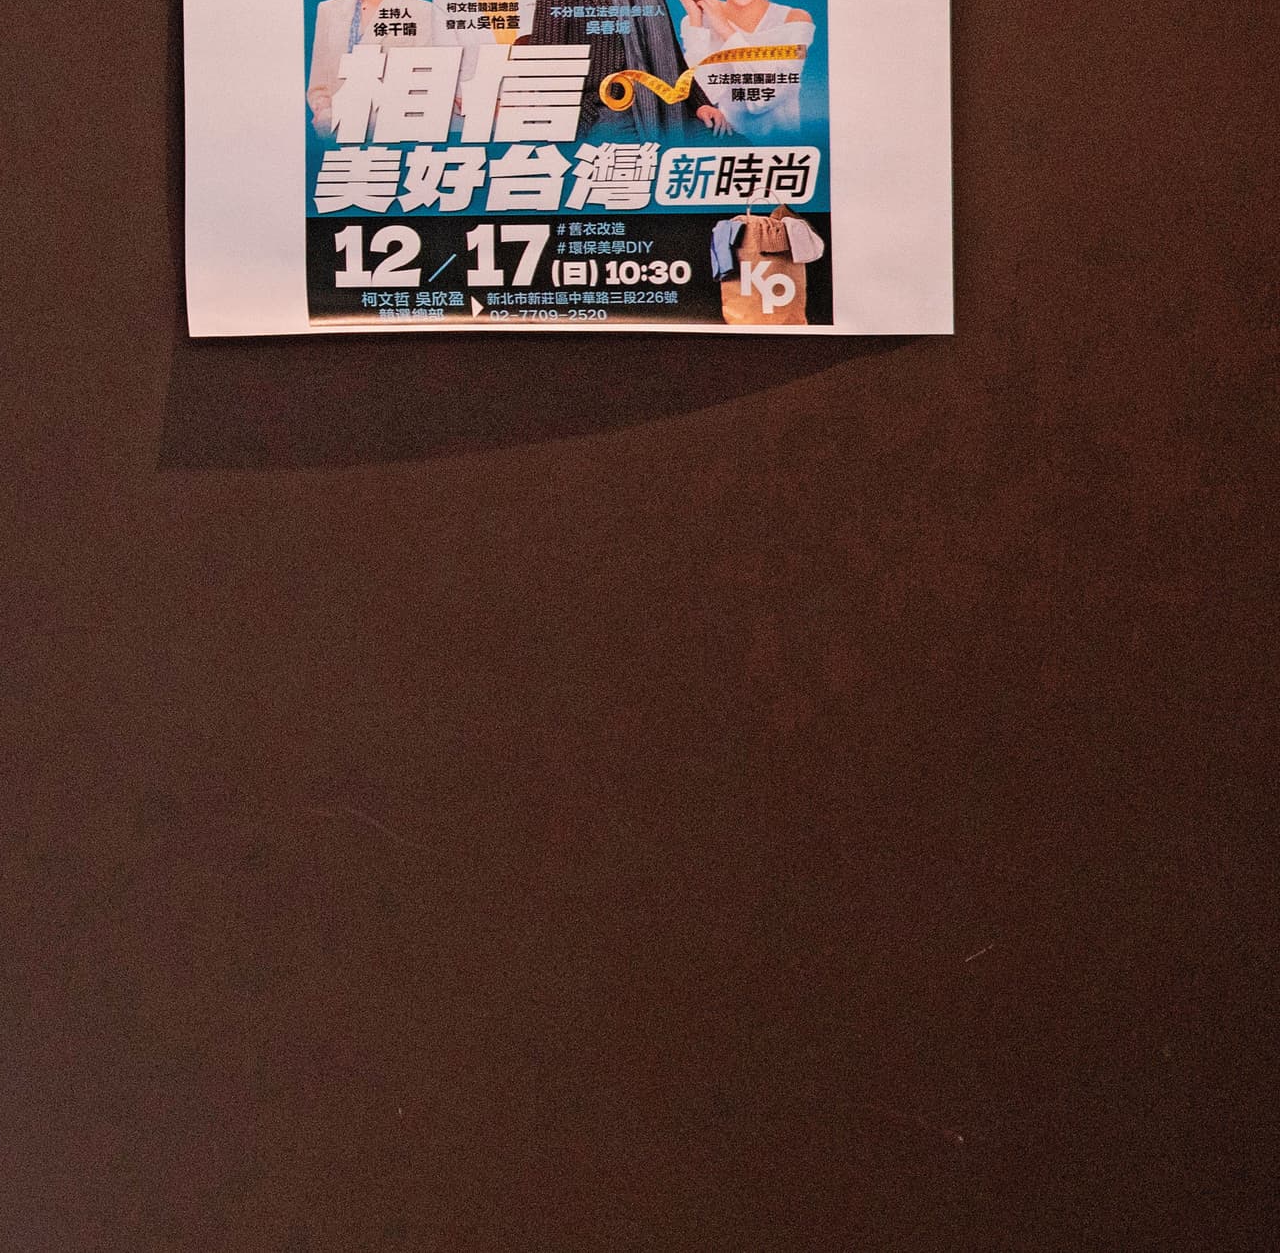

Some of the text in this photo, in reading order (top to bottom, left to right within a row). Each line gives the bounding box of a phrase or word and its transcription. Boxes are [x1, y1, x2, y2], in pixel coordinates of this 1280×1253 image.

[378, 7, 412, 19] 主持人
[446, 2, 520, 13] 柯文哲競選總部
[707, 72, 800, 85] 立法院黨團副主任
[331, 44, 592, 144] 相信
[731, 87, 776, 102] 陳思宇
[313, 143, 813, 214] 美好台灣 新時尚
[605, 260, 692, 285] 10:30
[361, 291, 465, 307] 柯文哲 吳欣盈
[486, 290, 679, 306] 新北市新莊區中華路三段226號
[490, 308, 608, 322] 02-7709-2520
